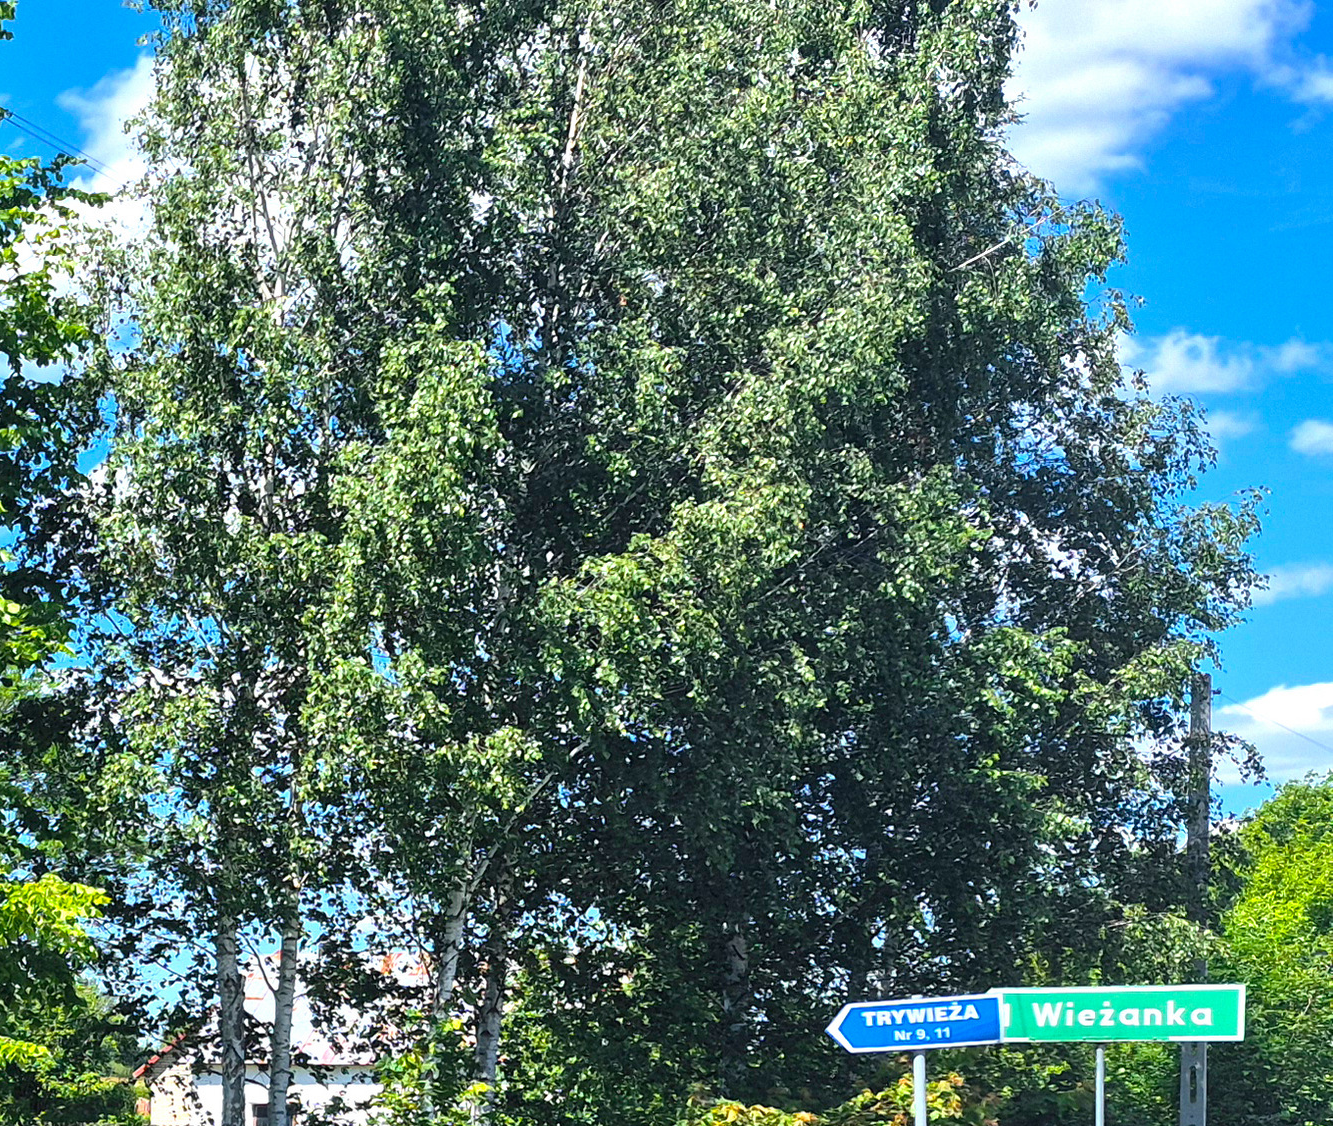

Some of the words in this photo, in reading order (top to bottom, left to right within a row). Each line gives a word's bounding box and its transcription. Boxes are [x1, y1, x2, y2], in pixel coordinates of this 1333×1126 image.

[860, 1002, 980, 1027] TRYWIEŻA
[1032, 1000, 1213, 1027] Wieżanka
[893, 1029, 913, 1041] Nr
[934, 1027, 951, 1039] 11
